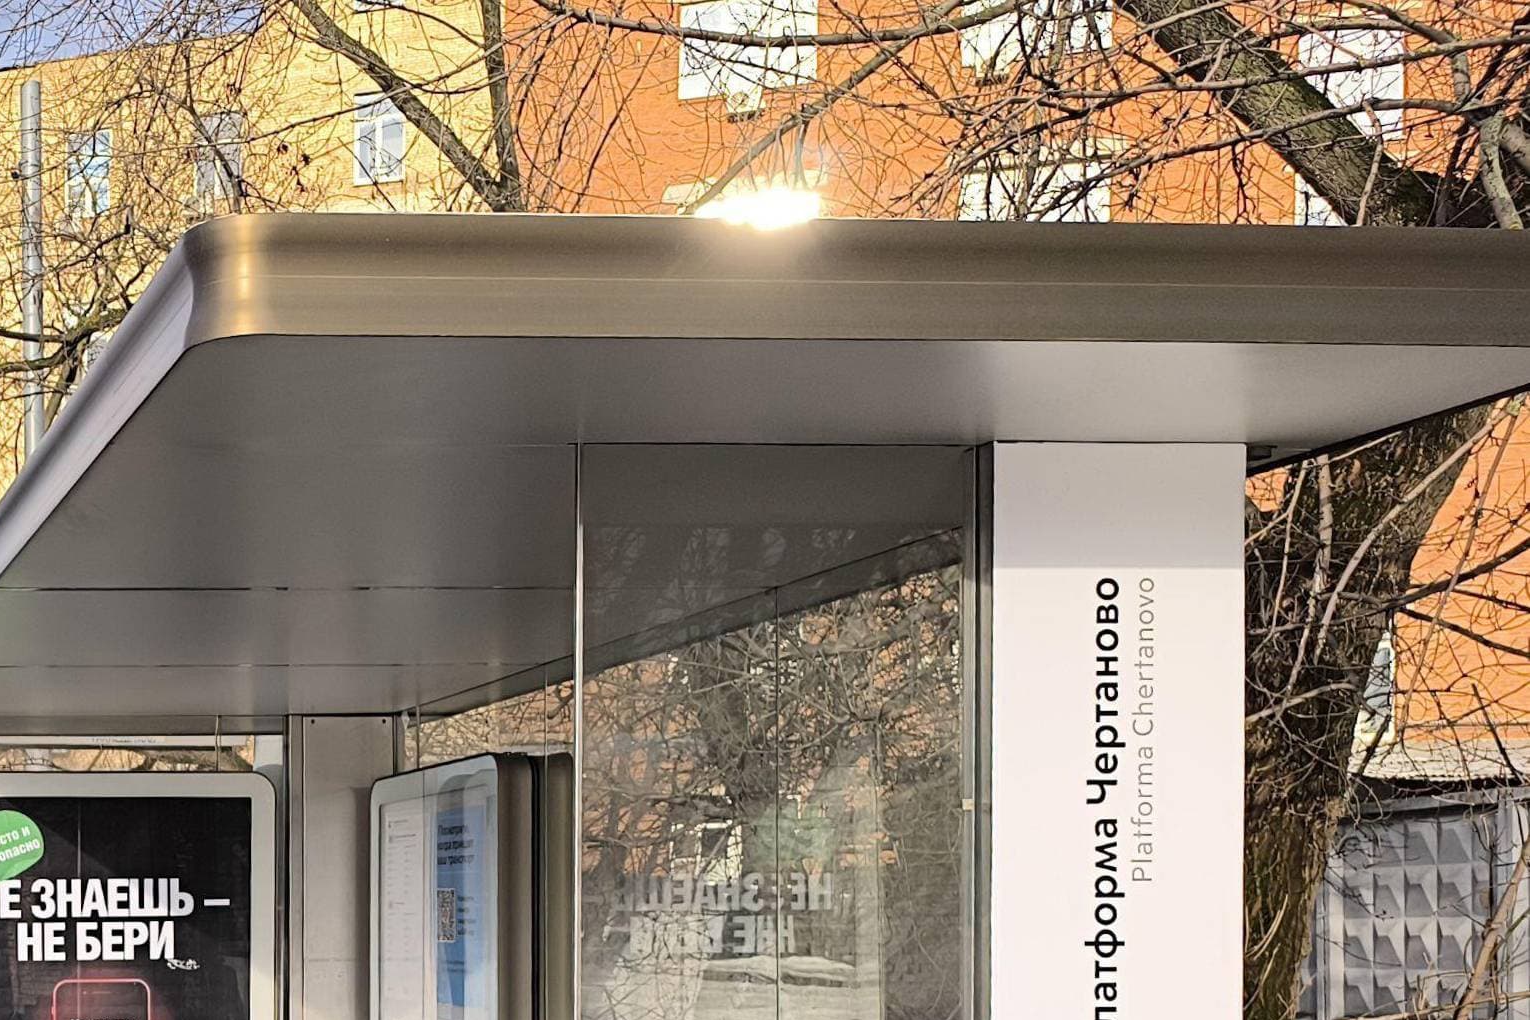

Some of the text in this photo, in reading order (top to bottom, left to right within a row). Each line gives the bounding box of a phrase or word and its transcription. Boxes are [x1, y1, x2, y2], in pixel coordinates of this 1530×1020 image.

[1086, 577, 1126, 805] Чертаново
[1130, 577, 1155, 882] Platforma Chertanovo
[21, 826, 31, 837] и
[30, 878, 195, 919] ЗНАЕШЬ
[17, 921, 175, 961] НЕ БЕРИ
